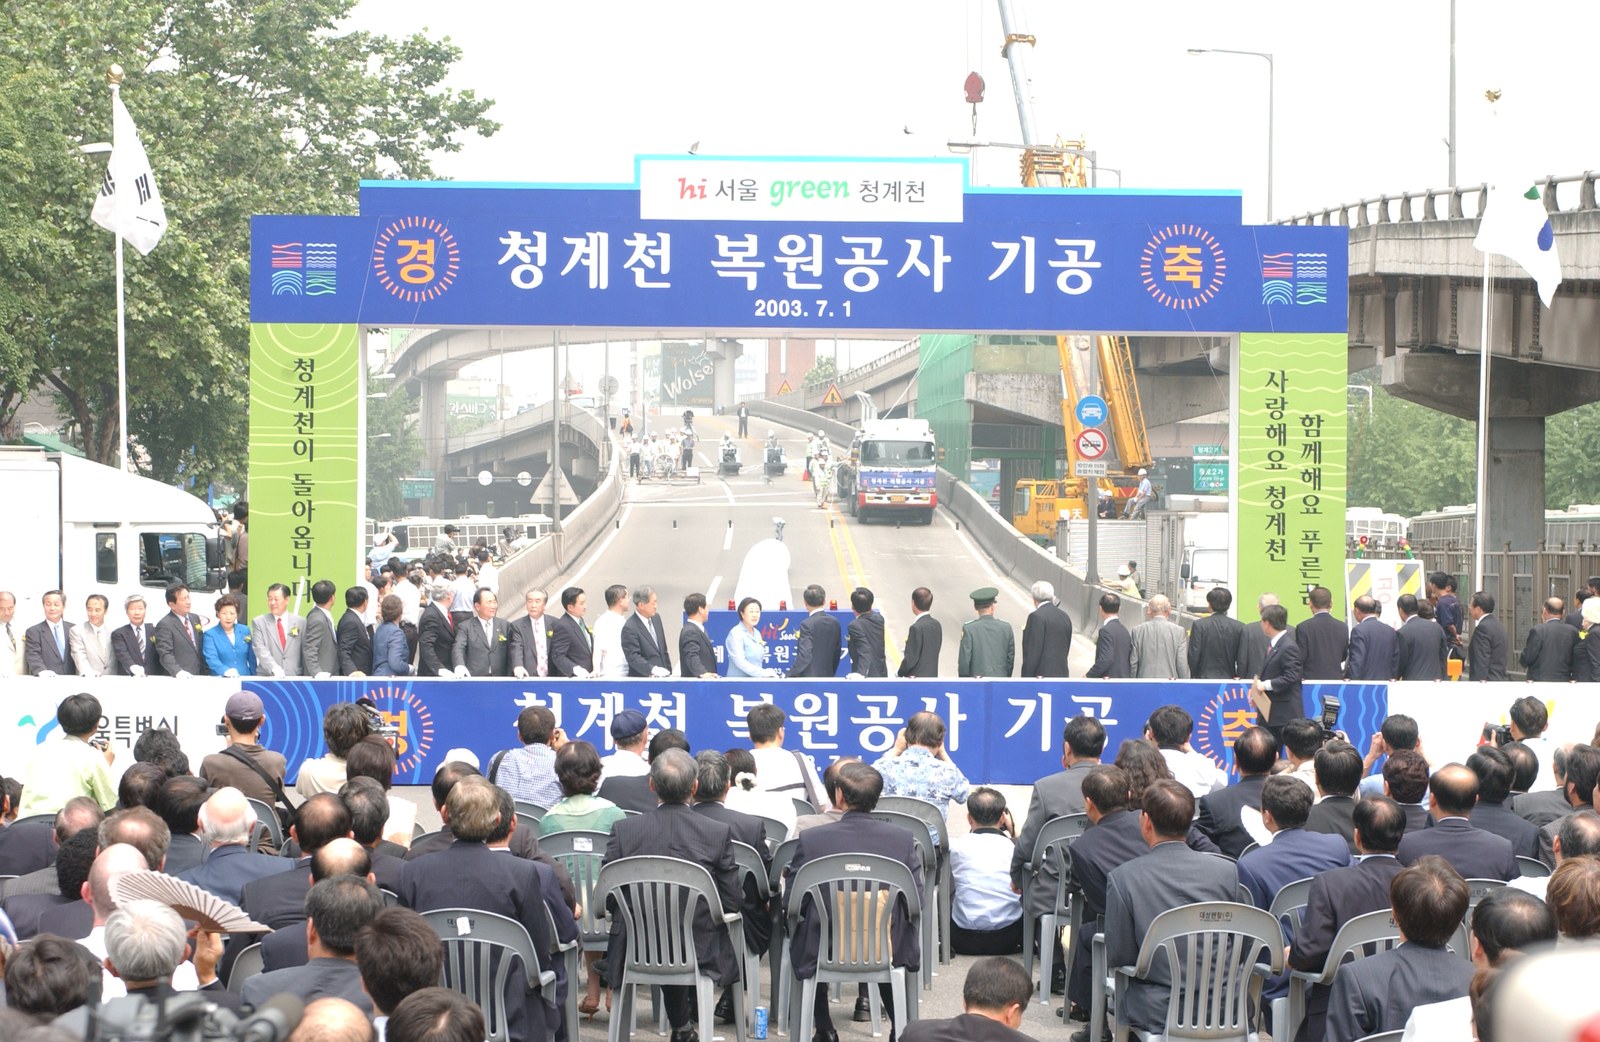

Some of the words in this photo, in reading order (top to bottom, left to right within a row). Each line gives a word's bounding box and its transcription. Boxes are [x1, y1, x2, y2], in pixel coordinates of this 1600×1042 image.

[678, 177, 707, 200] hi
[715, 178, 759, 202] 서울
[769, 179, 850, 207] green
[859, 180, 925, 203] 청계천
[398, 239, 434, 284] 경
[497, 230, 672, 290] 청계천
[711, 233, 952, 293] 복원공사
[989, 235, 1103, 295] 기공
[1164, 245, 1203, 288] 축
[754, 299, 809, 317] 2003.
[293, 358, 315, 463] 청계천이
[1265, 370, 1289, 470] 사랑해요
[1299, 414, 1325, 515] 함께해요
[291, 473, 316, 603] 돌아옵니다
[1265, 485, 1287, 562] 청계천
